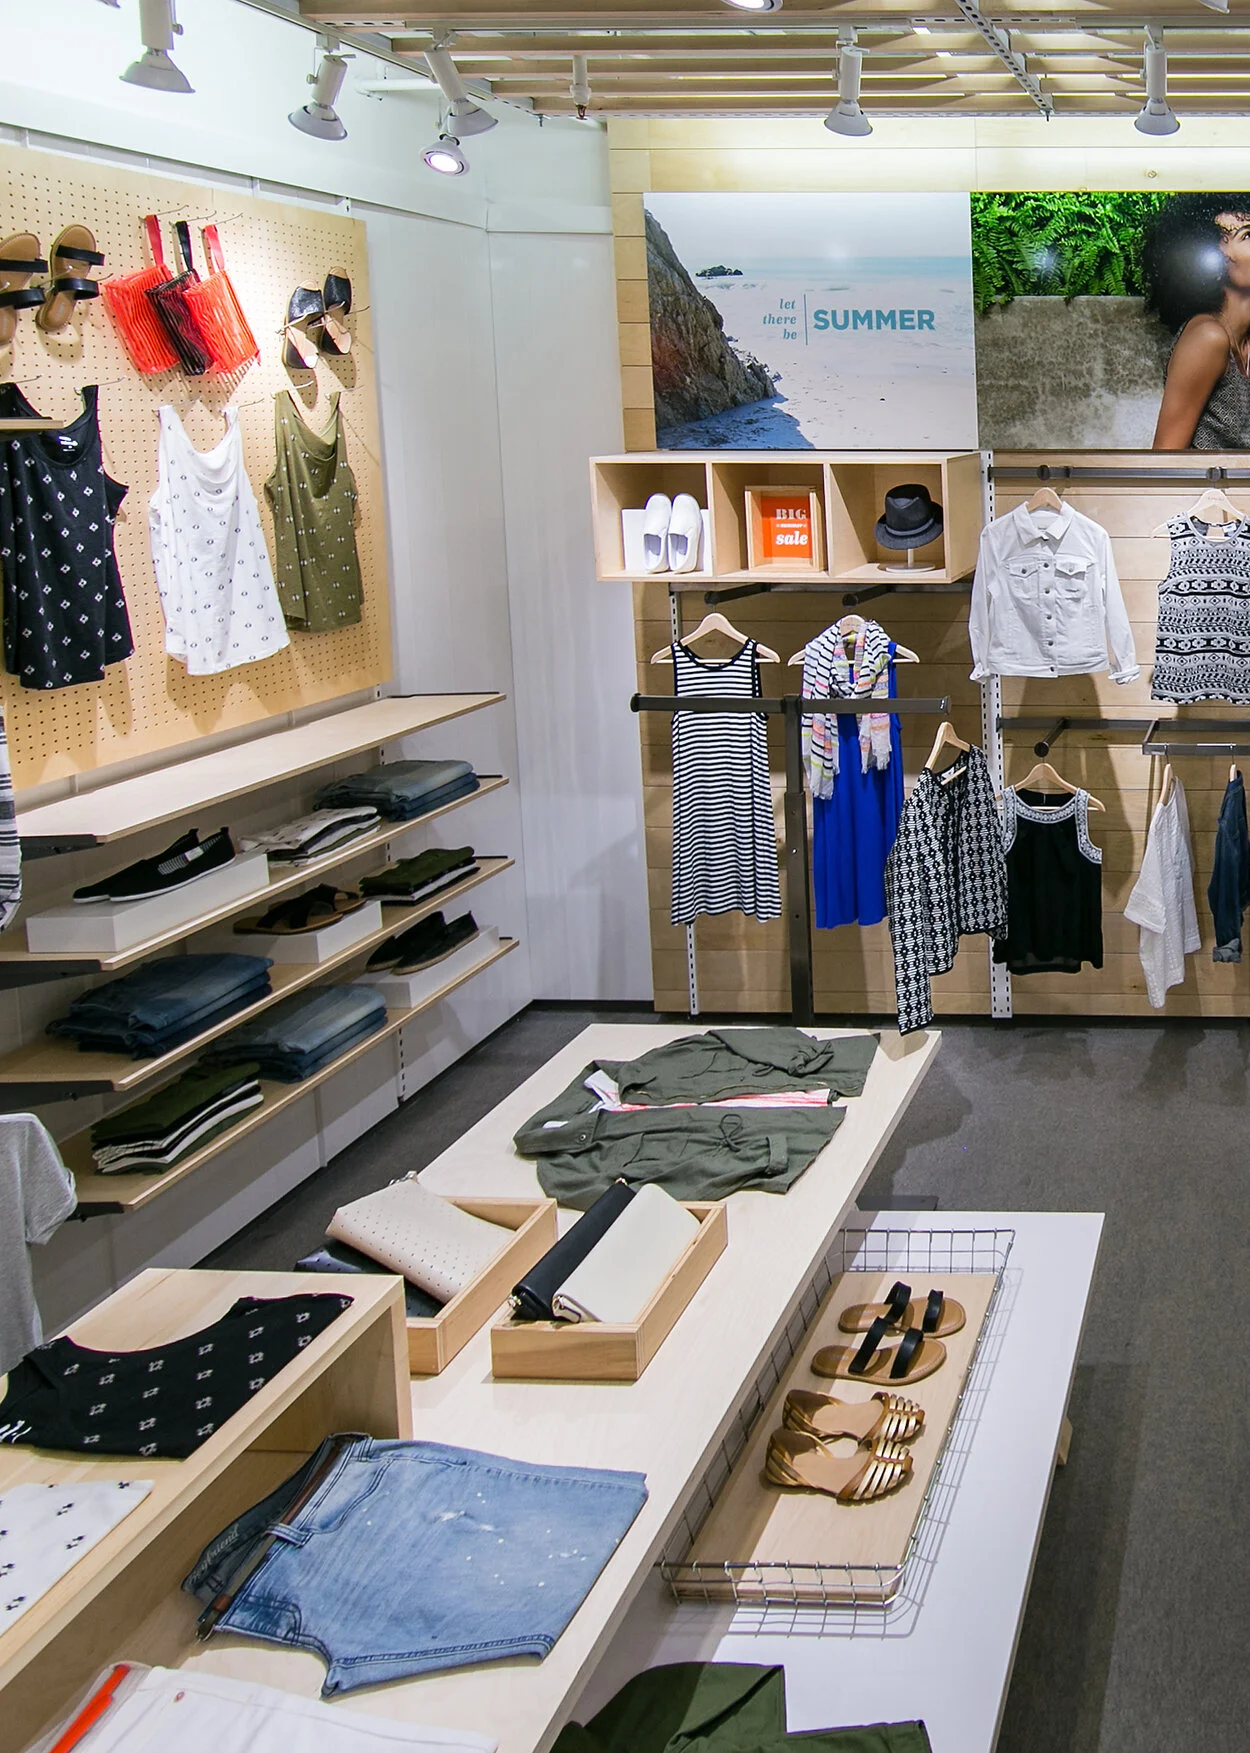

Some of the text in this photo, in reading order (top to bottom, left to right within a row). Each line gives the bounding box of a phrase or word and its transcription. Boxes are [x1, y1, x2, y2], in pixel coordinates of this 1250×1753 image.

[779, 298, 796, 310] let
[762, 313, 797, 325] there
[812, 309, 936, 331] SUMMER
[782, 328, 797, 340] be
[775, 508, 807, 520] BIG
[775, 530, 808, 546] sale
